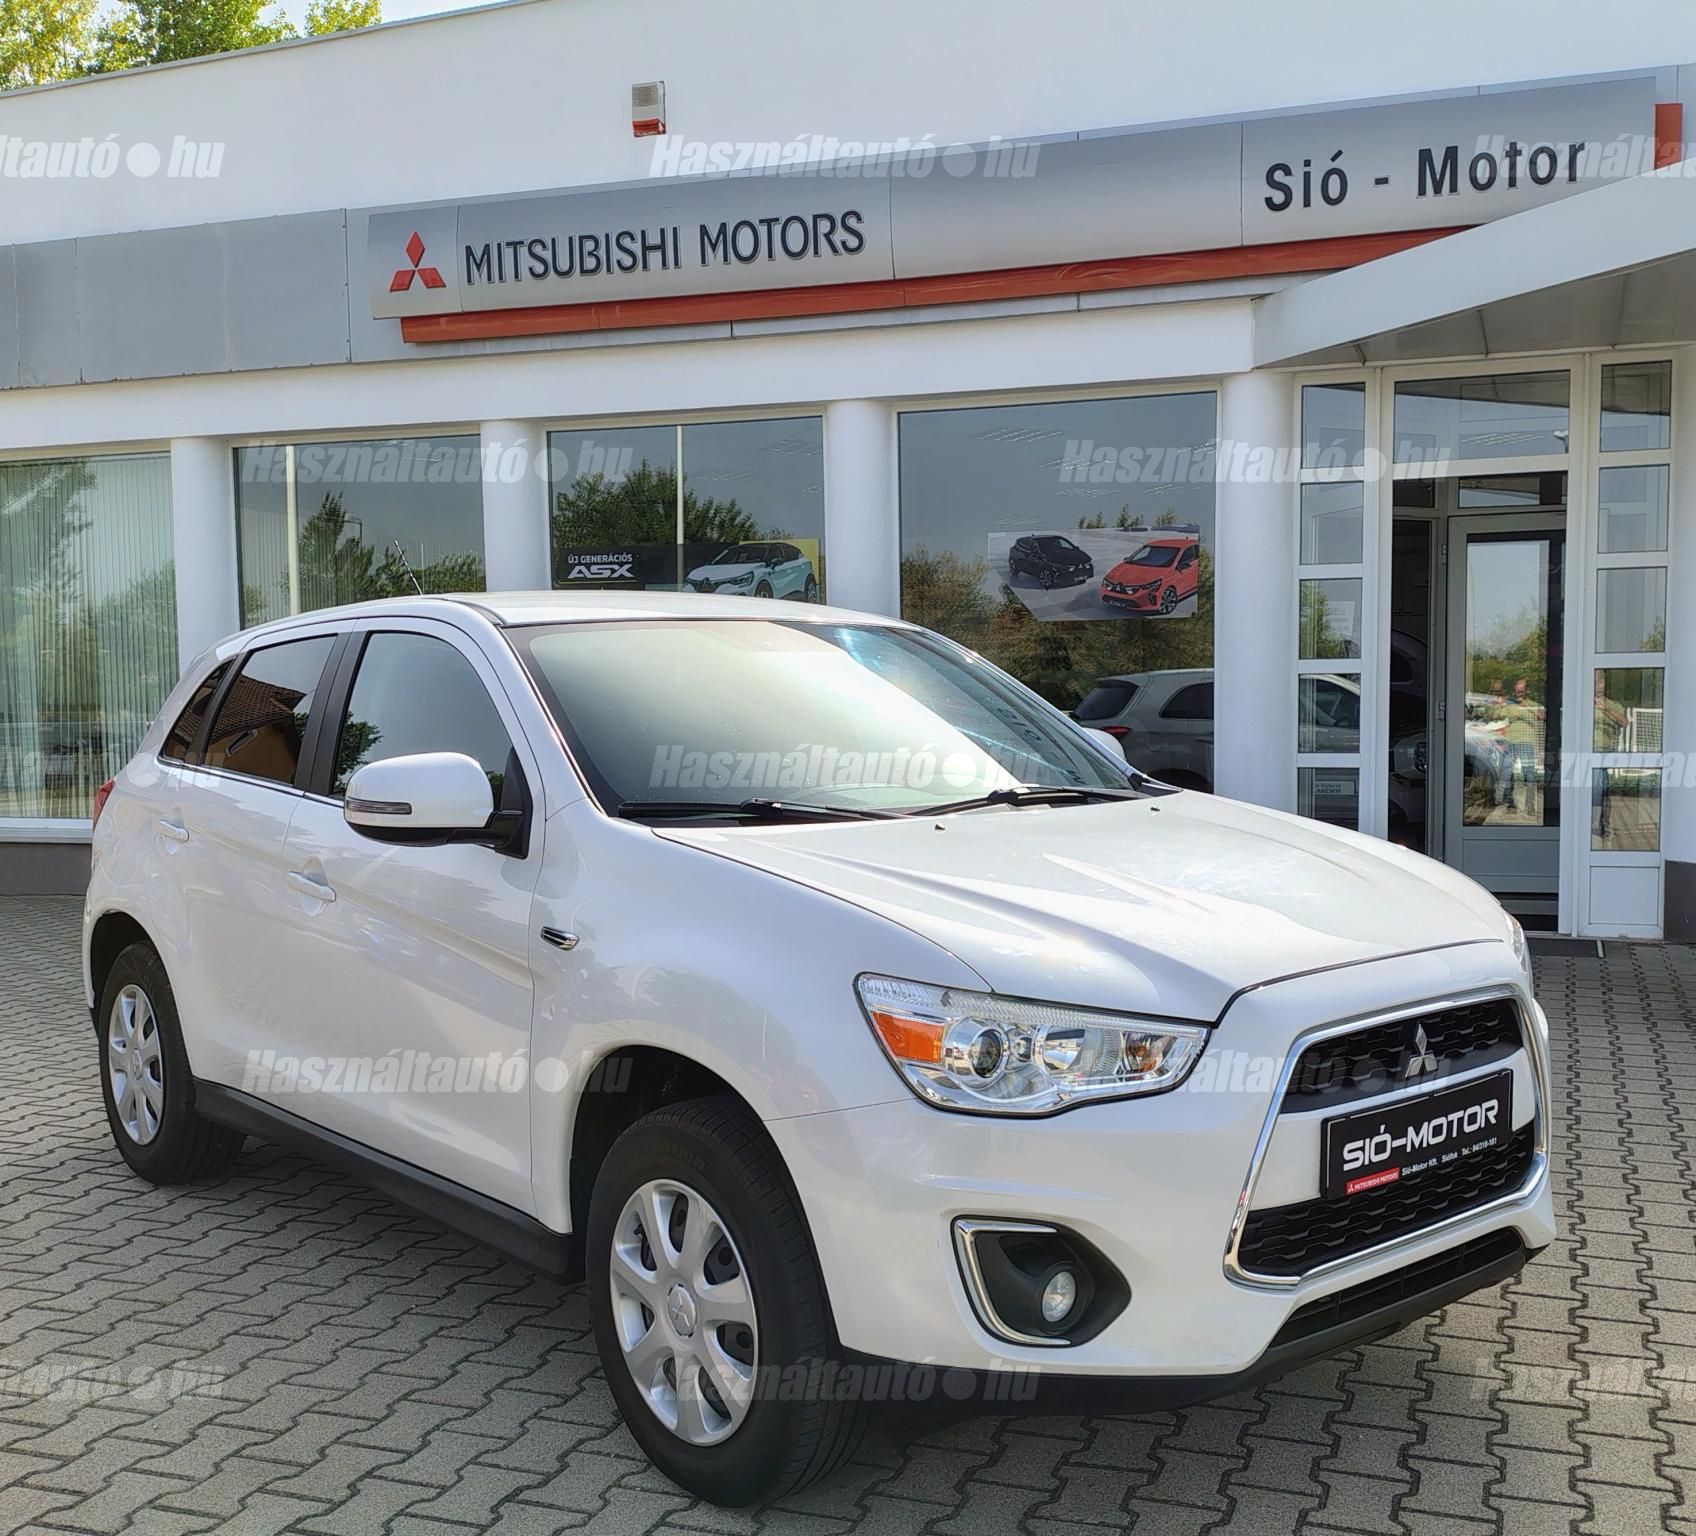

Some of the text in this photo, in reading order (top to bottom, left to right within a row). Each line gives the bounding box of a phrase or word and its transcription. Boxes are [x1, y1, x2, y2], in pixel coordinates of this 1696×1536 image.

[1264, 149, 1349, 212] Sió
[1416, 142, 1586, 198] Motor
[465, 210, 867, 286] MITSUBISHI MOTORS
[567, 564, 635, 579] ASX
[580, 552, 633, 564] GENERÁCIÓS
[1343, 1099, 1499, 1171] SIÓ-MOTOR
